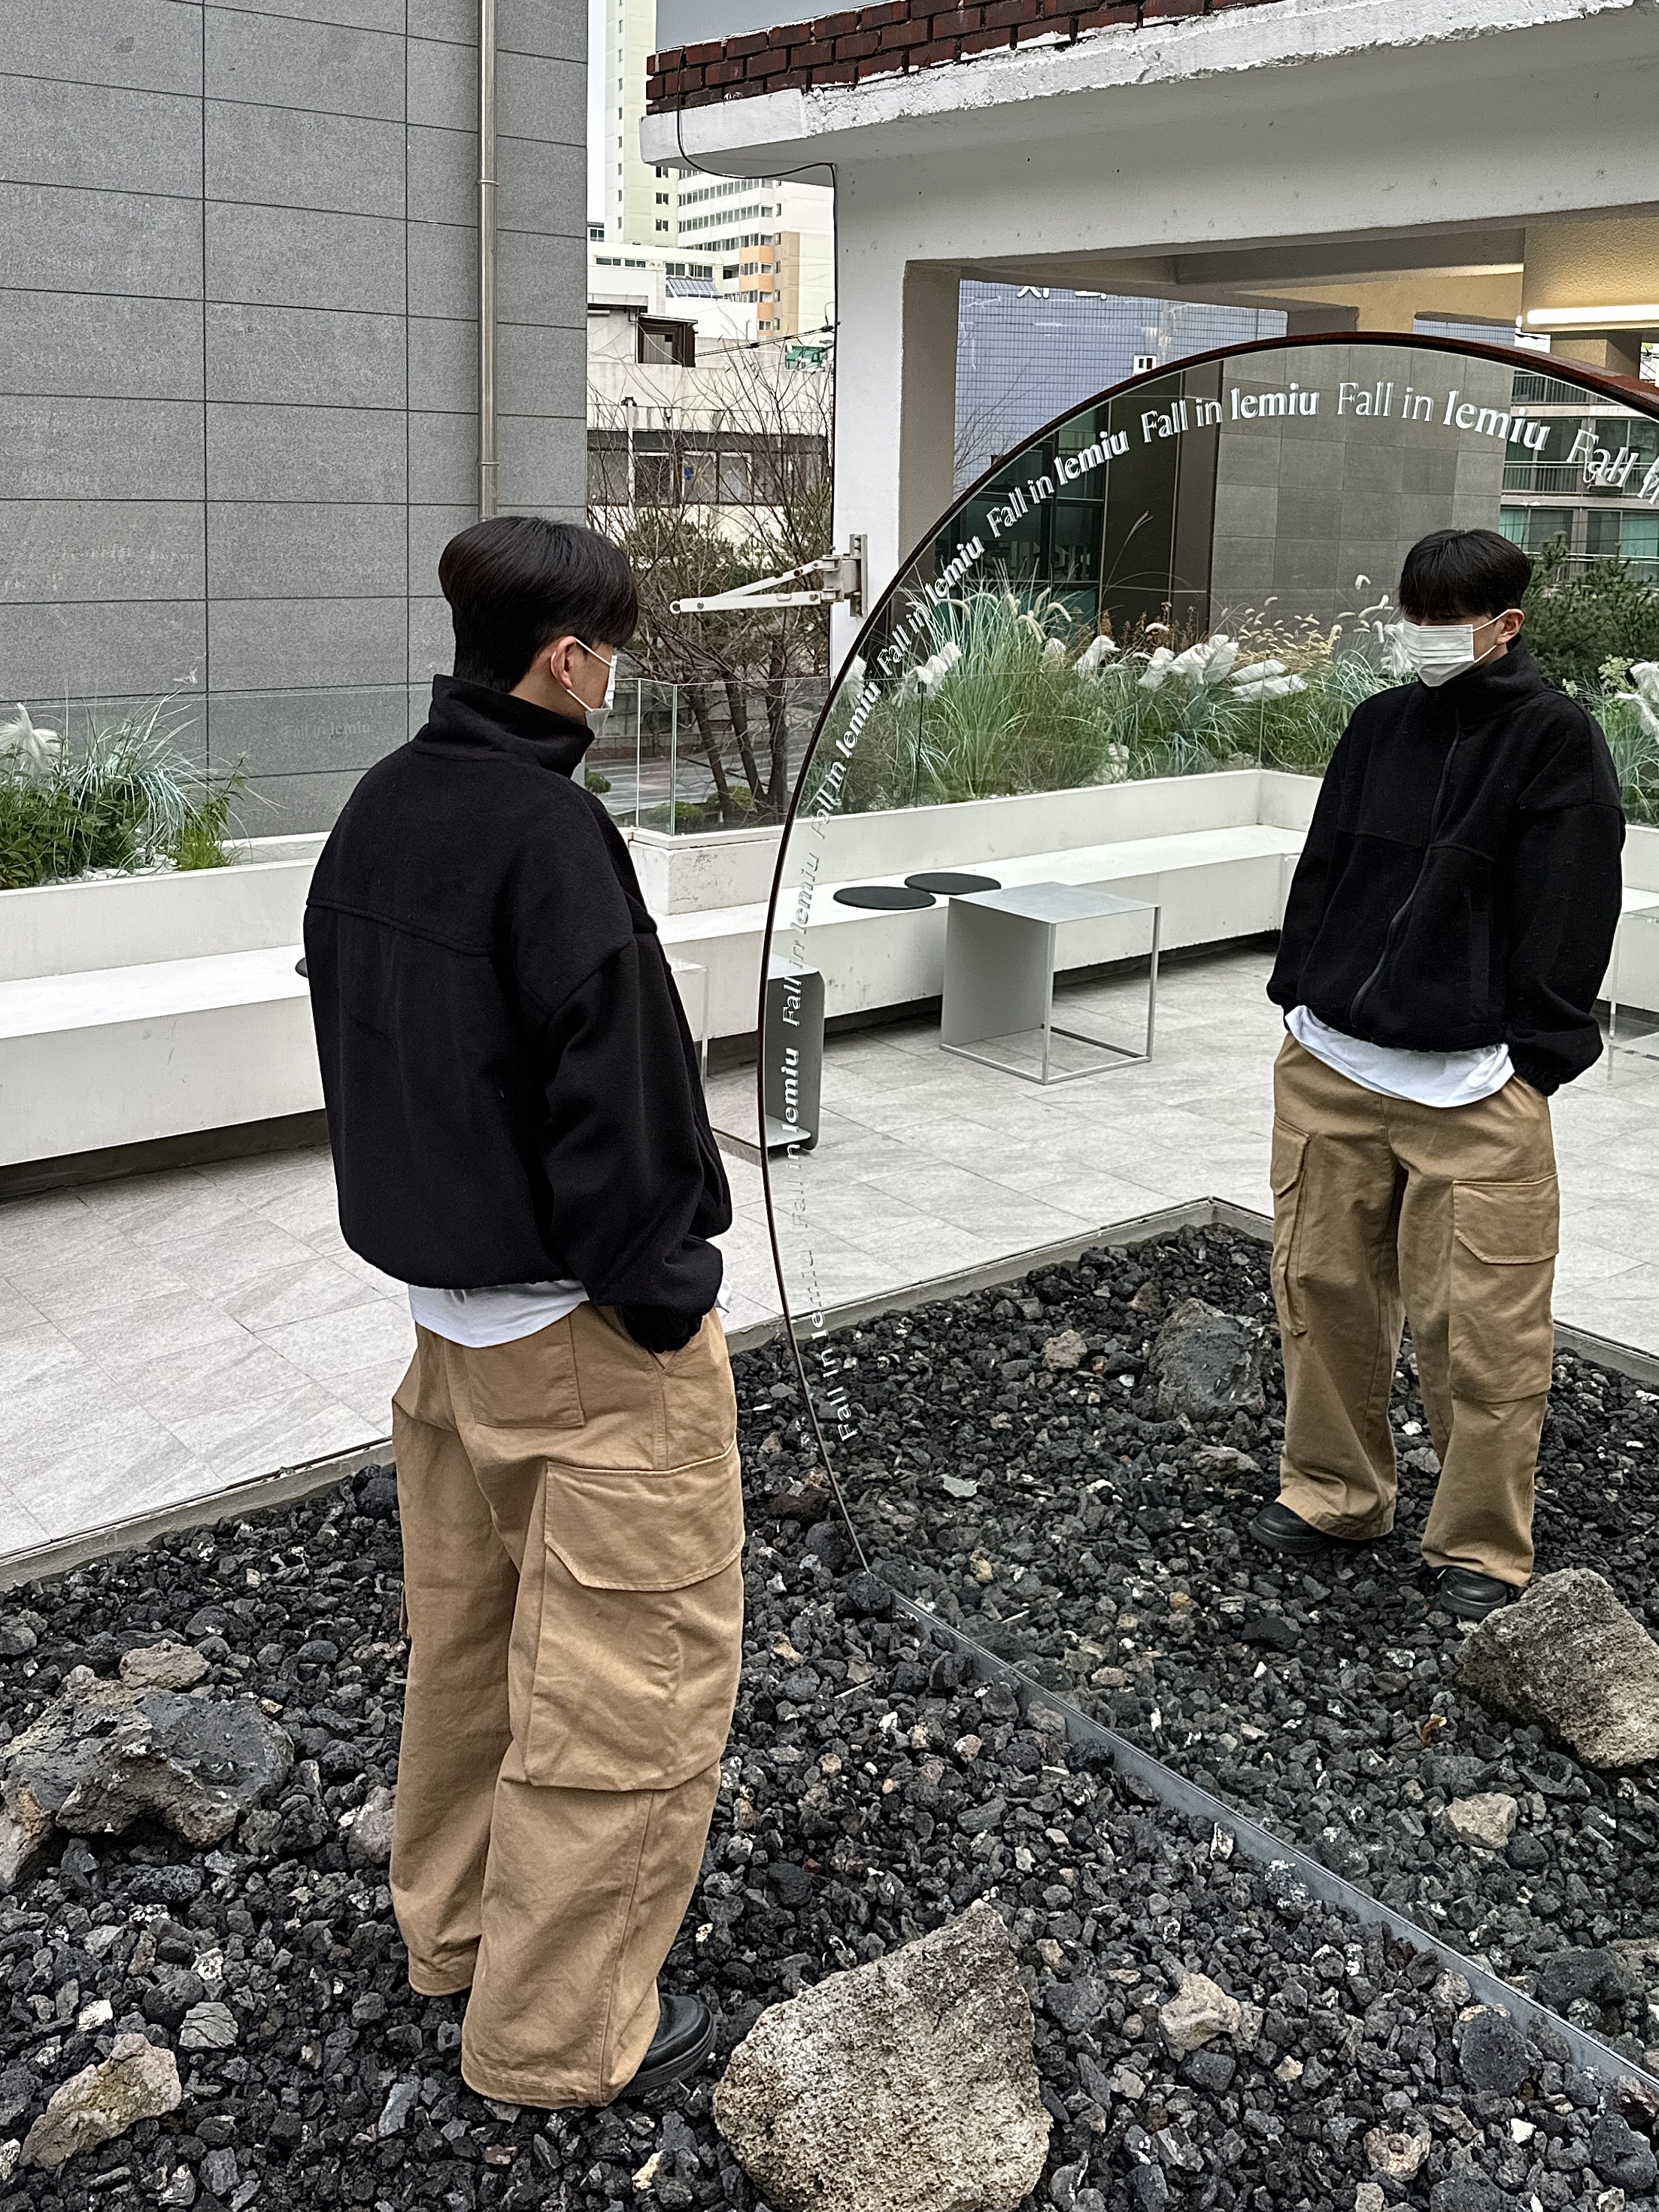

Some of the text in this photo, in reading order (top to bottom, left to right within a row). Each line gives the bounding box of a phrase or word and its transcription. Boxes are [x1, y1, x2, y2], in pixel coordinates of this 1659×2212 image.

[1140, 382, 1320, 443] Fall in lemiu
[1337, 381, 1551, 451] Fall in lemiu
[986, 430, 1130, 538] Fall in lemiu
[1566, 428, 1639, 487] Fall
[877, 536, 985, 675] Fall in lemiu
[824, 761, 847, 789] in
[836, 681, 881, 759] lemiu
[790, 852, 819, 935] lemiu
[783, 976, 802, 1027] Fall
[781, 1047, 799, 1133] lemiu
[821, 1349, 839, 1378] in
[827, 1386, 858, 1441] Fall
